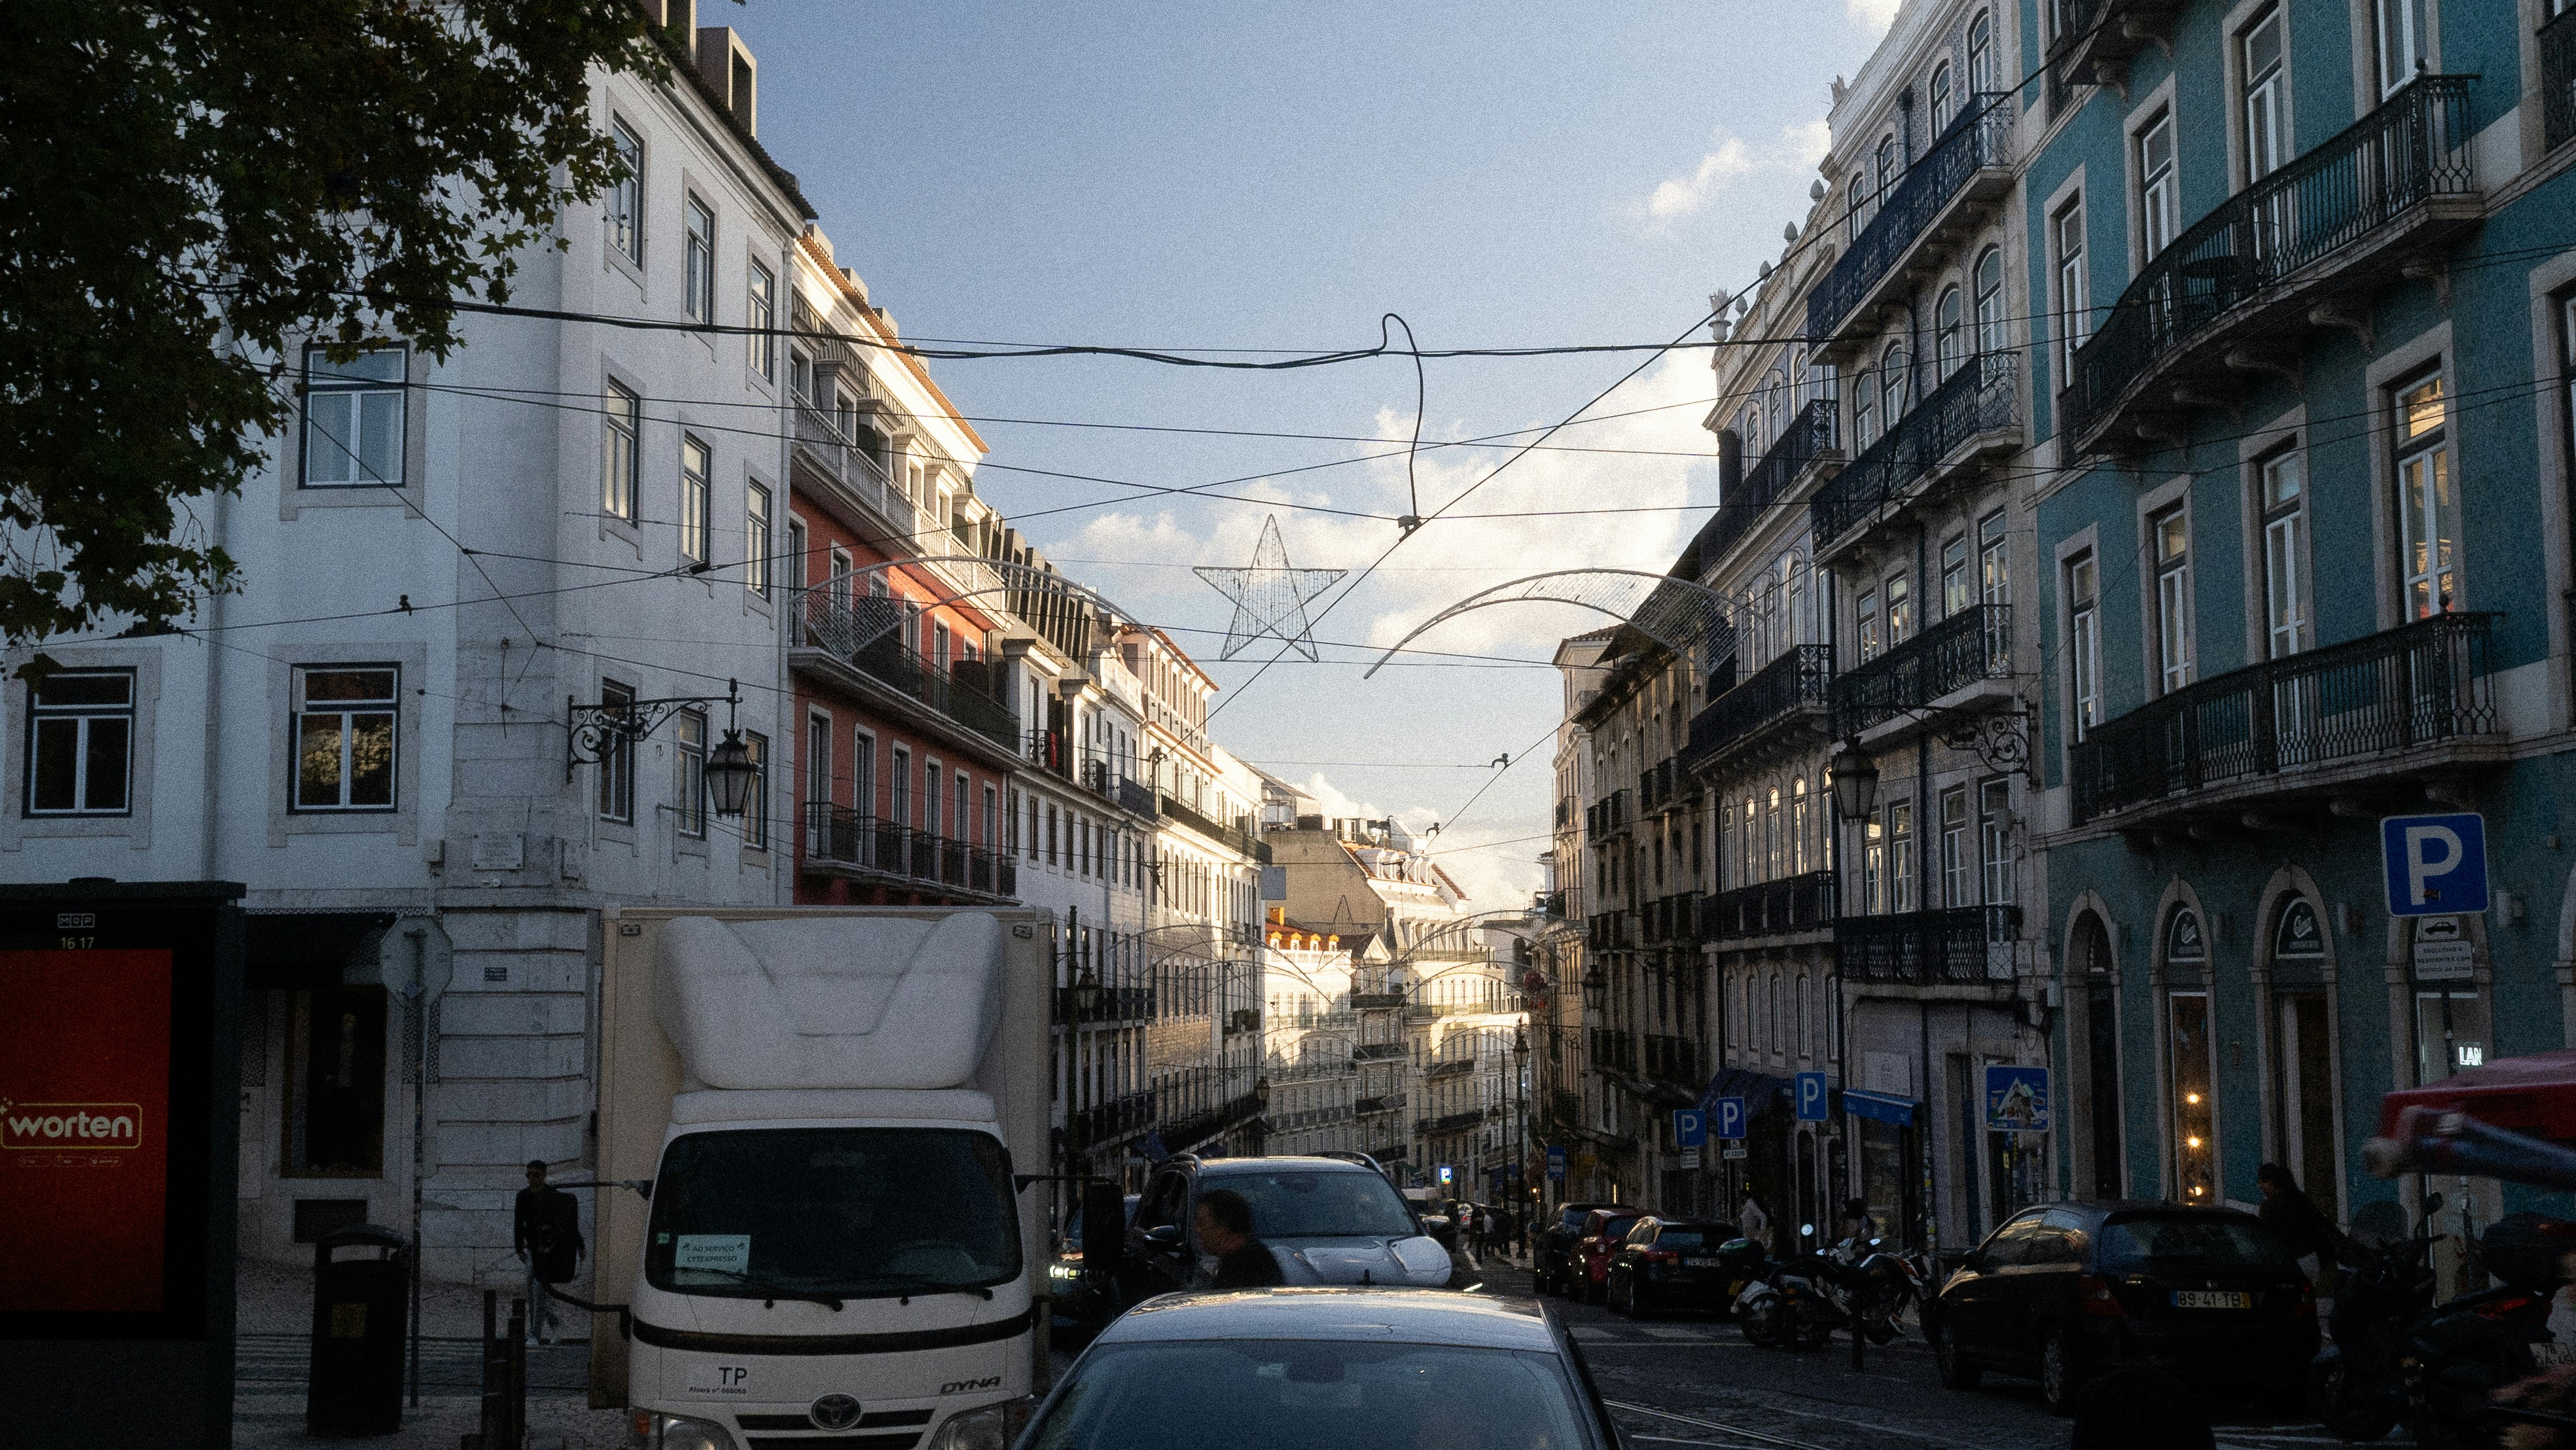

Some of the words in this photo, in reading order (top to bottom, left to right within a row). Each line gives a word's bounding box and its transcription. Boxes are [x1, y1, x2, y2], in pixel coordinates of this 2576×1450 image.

[2405, 826, 2463, 906] P
[58, 914, 95, 927] MOP
[60, 936, 76, 949] 16
[79, 936, 95, 949] 17
[1802, 1078, 1819, 1114] P
[8, 1110, 134, 1138] worten
[1681, 1114, 1698, 1142] P
[1722, 1102, 1739, 1135] P
[718, 1367, 747, 1385] TP
[940, 1376, 1001, 1394] DYNA
